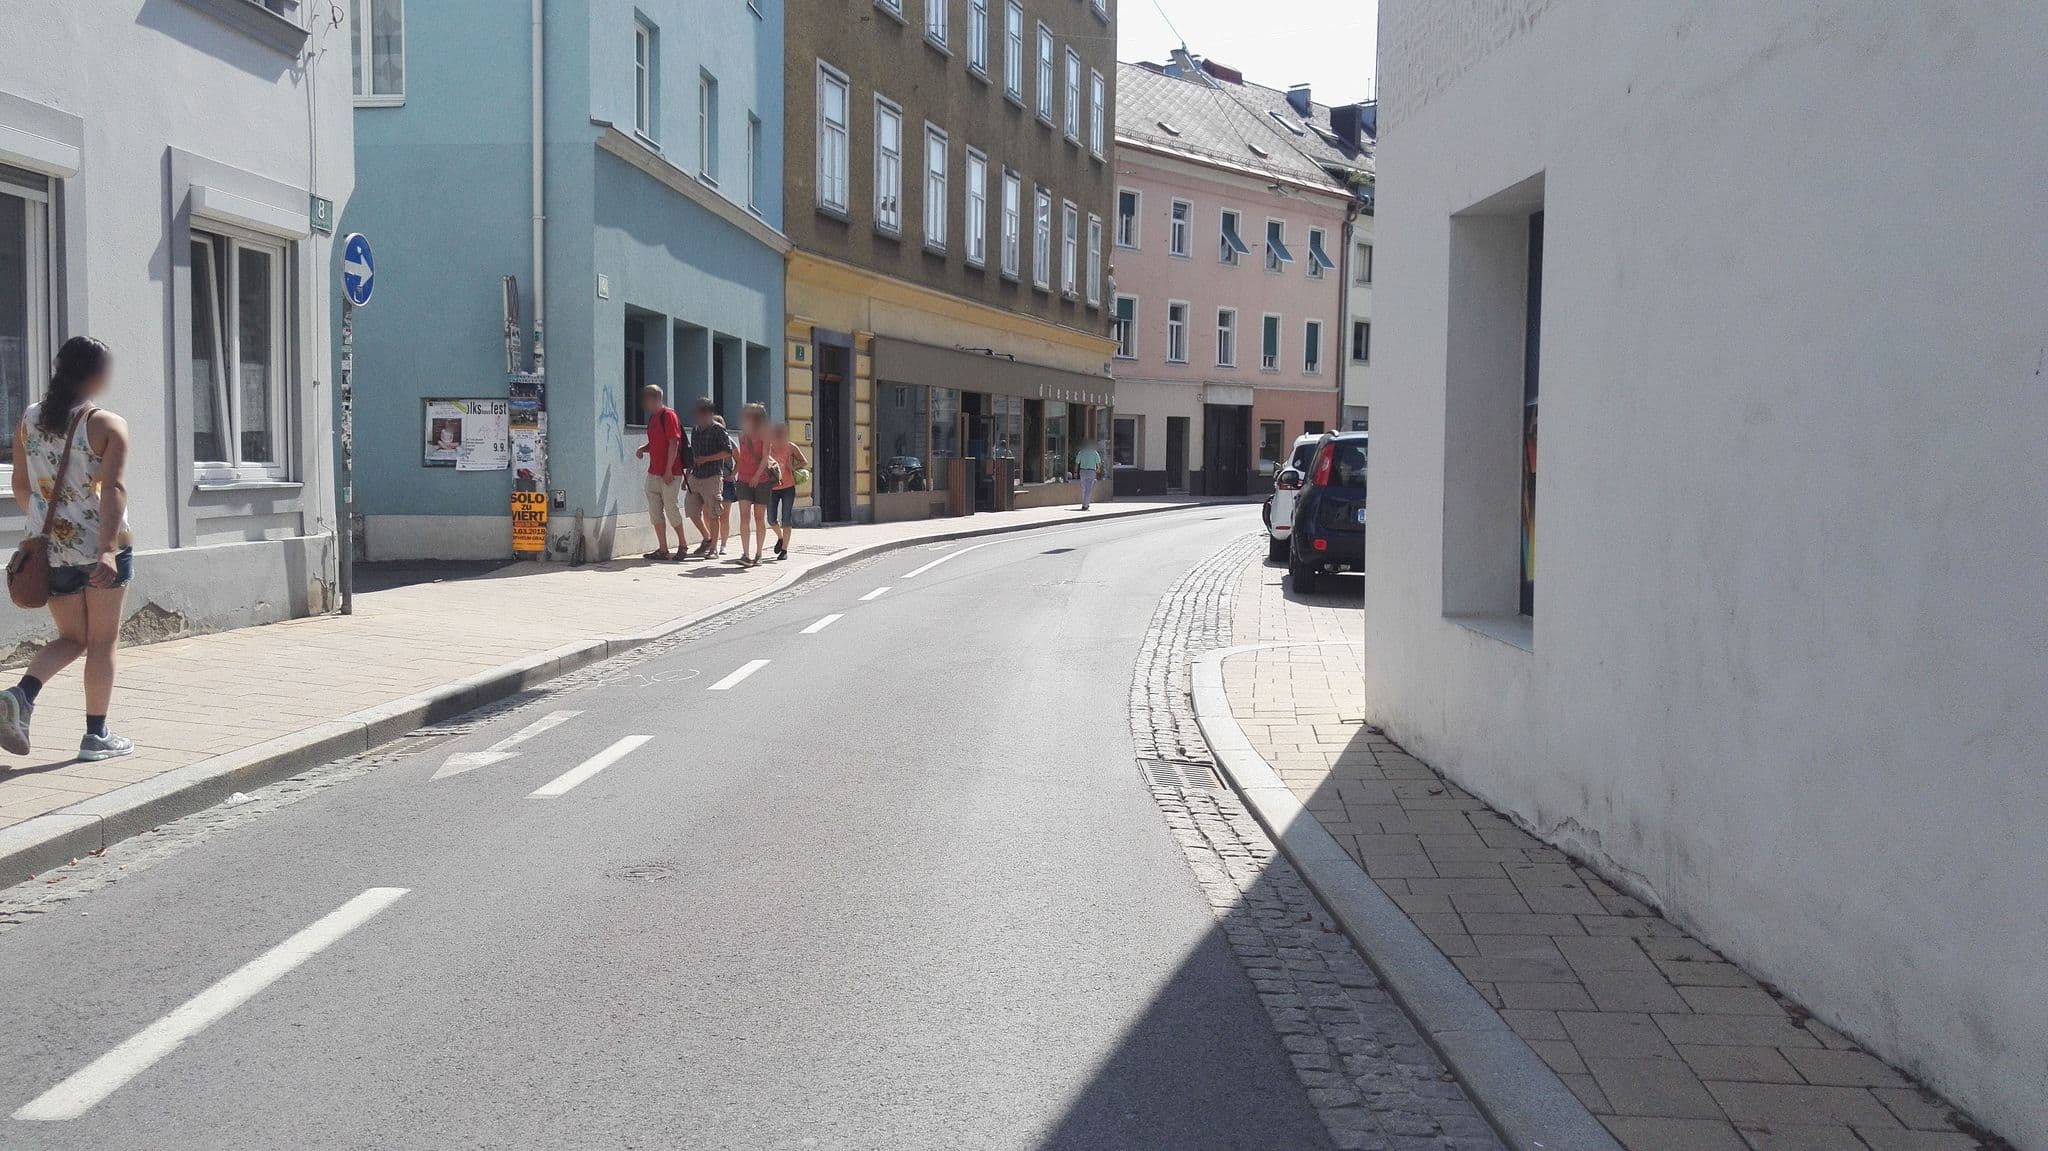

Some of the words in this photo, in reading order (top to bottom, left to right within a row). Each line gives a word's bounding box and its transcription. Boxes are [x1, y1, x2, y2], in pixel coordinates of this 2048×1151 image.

[318, 199, 325, 219] 8
[491, 401, 506, 415] fest
[511, 493, 545, 504] SOLO
[512, 511, 544, 521] VIERT
